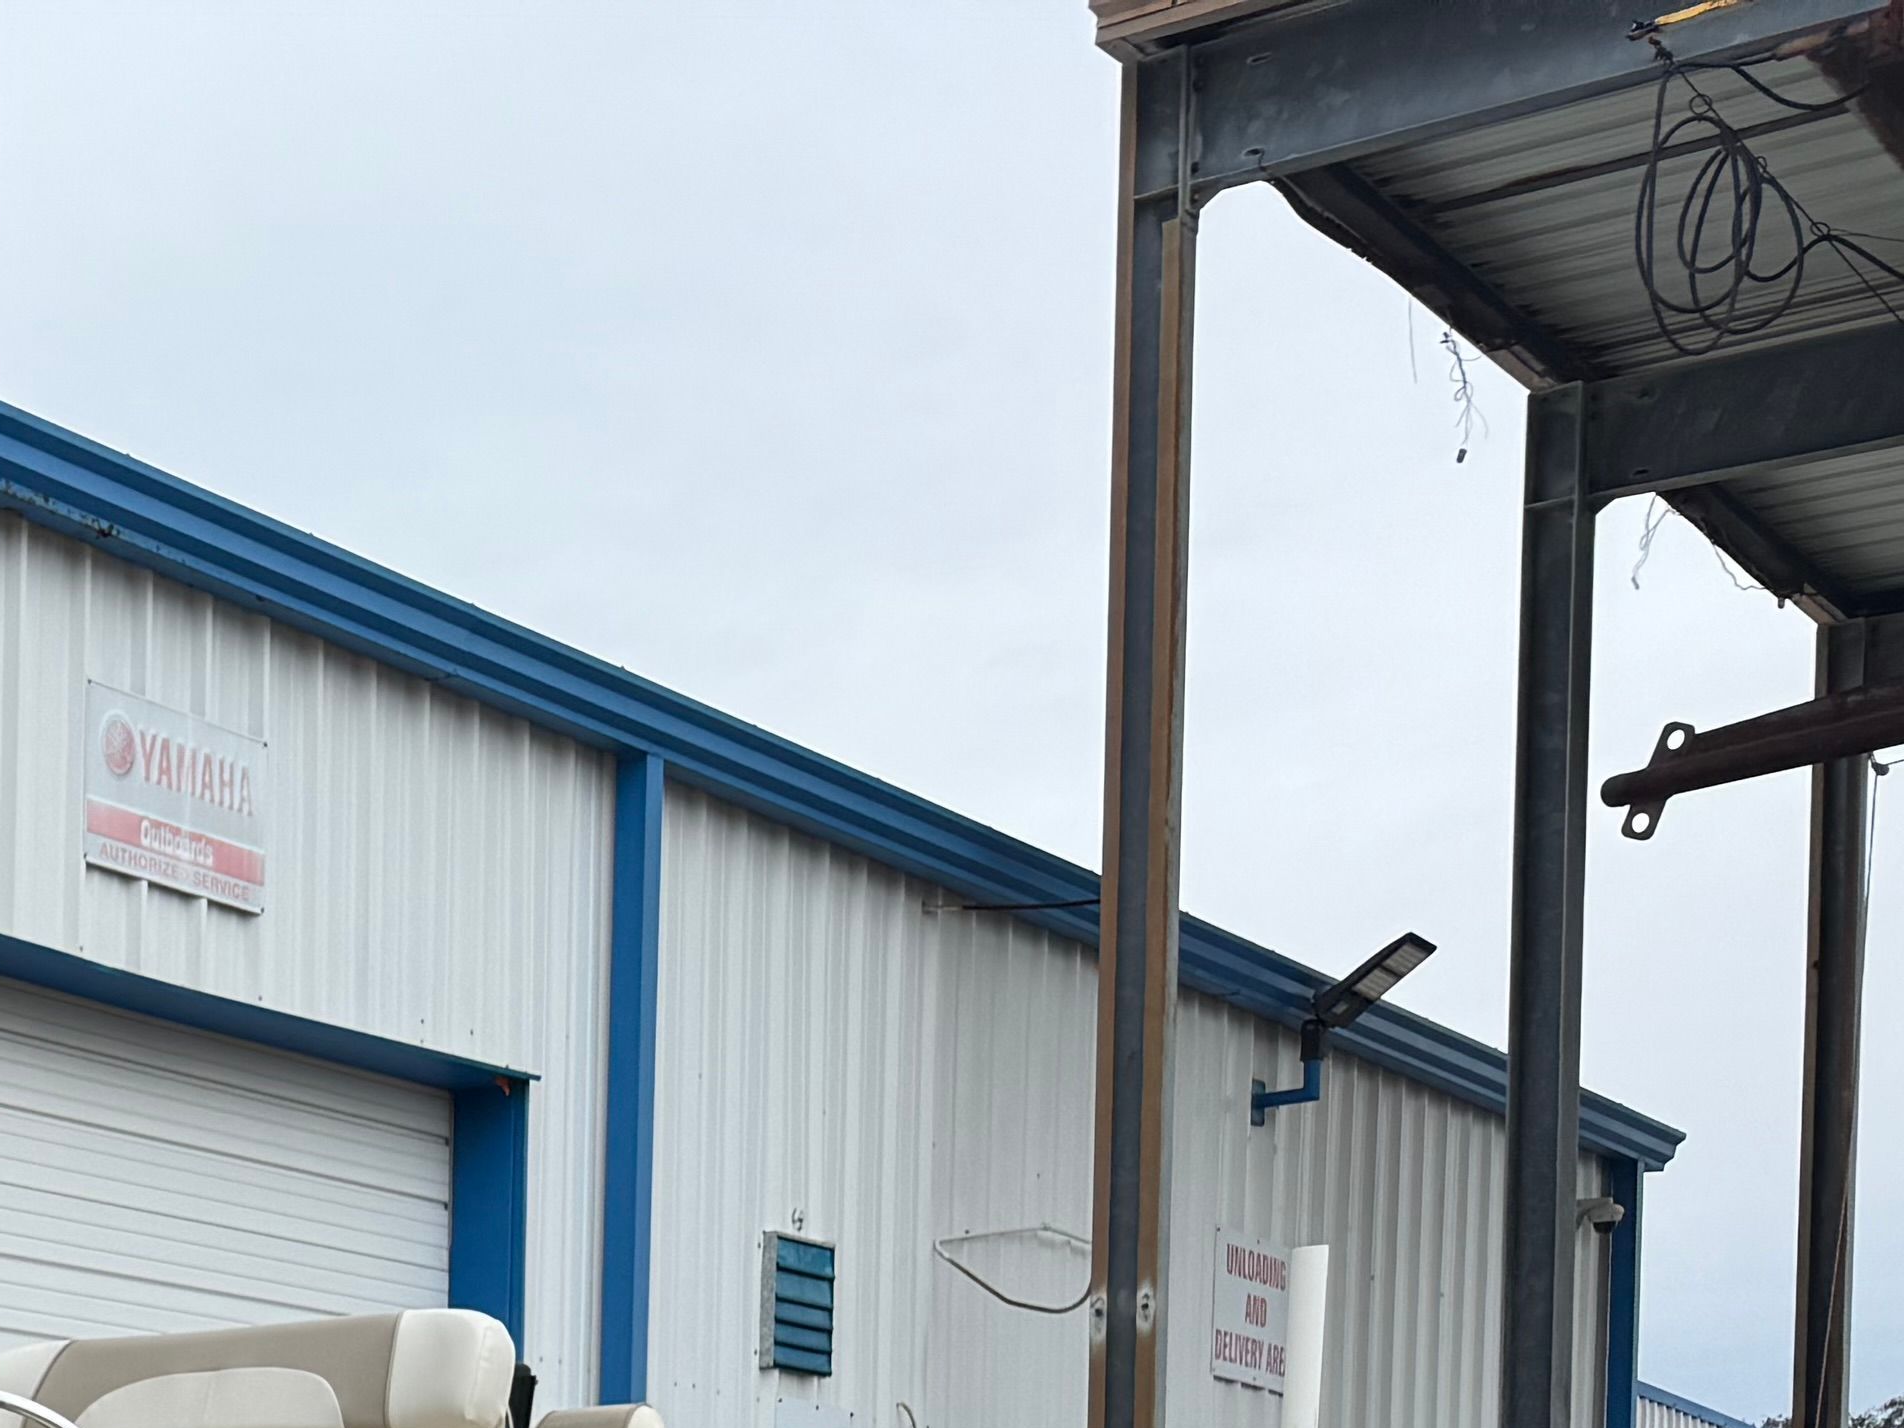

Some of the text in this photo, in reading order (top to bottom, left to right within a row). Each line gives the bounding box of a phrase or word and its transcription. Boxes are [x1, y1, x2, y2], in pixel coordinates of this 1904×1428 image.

[139, 728, 254, 817] YAMAHA
[193, 870, 250, 901] SERVICE
[1226, 1243, 1287, 1292] UNLOADING
[1245, 1293, 1268, 1328] AND
[1215, 1328, 1264, 1371] DELIVERY
